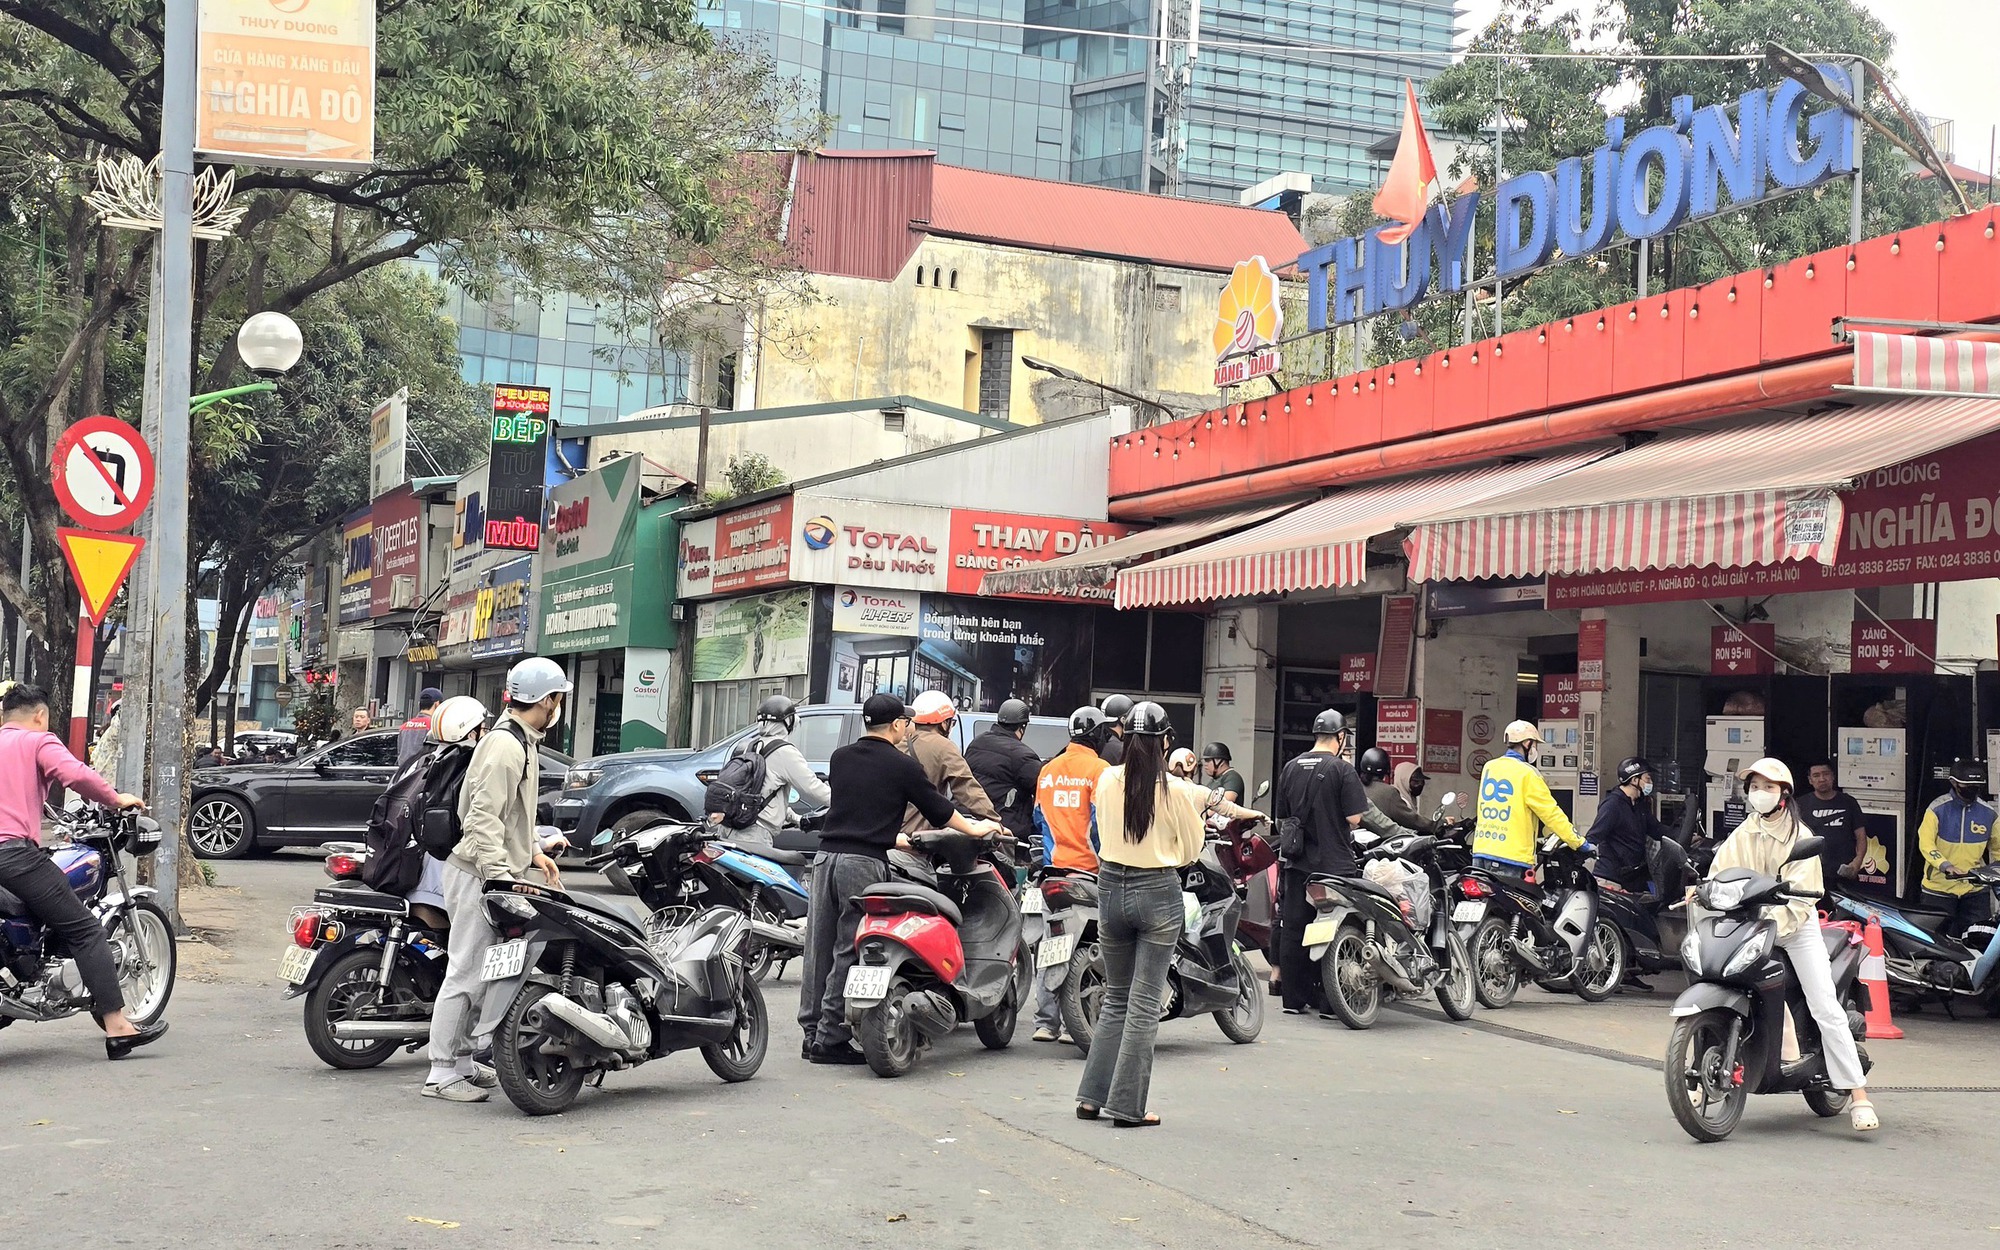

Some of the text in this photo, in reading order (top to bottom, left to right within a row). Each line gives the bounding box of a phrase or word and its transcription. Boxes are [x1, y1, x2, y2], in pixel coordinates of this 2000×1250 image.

[239, 15, 338, 36] THUY DUONG
[213, 45, 360, 76] CỬA HÀNG XĂNG DẦU
[210, 78, 362, 124] NGHĨA ĐÔ
[496, 387, 549, 402] FEUER
[494, 411, 546, 443] BẾP
[500, 446, 536, 475] TỪ
[1849, 492, 1956, 551] NGHĨA
[486, 515, 539, 548] MÙI
[843, 525, 938, 554] TOTAL
[973, 523, 1050, 553] THAY
[848, 553, 936, 575] Dầu Nhớt
[955, 549, 999, 572] BẰNG
[1838, 563, 1857, 577] 024
[1858, 560, 1884, 575] 3836
[1885, 557, 1912, 573] 2557
[1916, 555, 1938, 570] FAX:
[1940, 553, 1961, 568] 024
[1963, 550, 1991, 565] 3836
[1569, 586, 1580, 598] 181
[1580, 581, 1606, 597] HOÀNG
[1606, 579, 1628, 596] QUỐC
[1628, 579, 1644, 596] VIỆT
[1658, 574, 1682, 591] NGHĨA
[1683, 572, 1696, 589] ĐÔ
[1711, 571, 1729, 586] CẦU
[1730, 569, 1749, 586] GIẤY
[1756, 571, 1769, 584] TP.
[1770, 567, 1783, 583] HÀ
[1784, 565, 1800, 583] NỘI
[861, 595, 907, 608] TOTAL
[860, 608, 914, 623] HI-PERF
[924, 611, 1022, 630] Đồng hành bên bạn
[923, 629, 1045, 646] trong từng khoảnh khắc
[1723, 629, 1743, 643] XĂNG
[1862, 627, 1887, 640] XĂNG
[1715, 647, 1730, 660] RON
[1857, 645, 1879, 658] RON
[1882, 644, 1895, 658] 95
[1350, 656, 1366, 668] XĂNG
[633, 686, 659, 694] Castrol
[1558, 677, 1574, 691] DẦU
[1545, 692, 1579, 705] DO 0,05S
[405, 720, 427, 728] TOTAL
[1481, 768, 1514, 803] be
[1970, 820, 1987, 835] be
[1038, 948, 1068, 964] 748.11
[278, 962, 306, 982] 019.08
[482, 958, 521, 980] 712.10
[853, 969, 884, 982] 29-P1
[847, 983, 884, 997] 845.70
